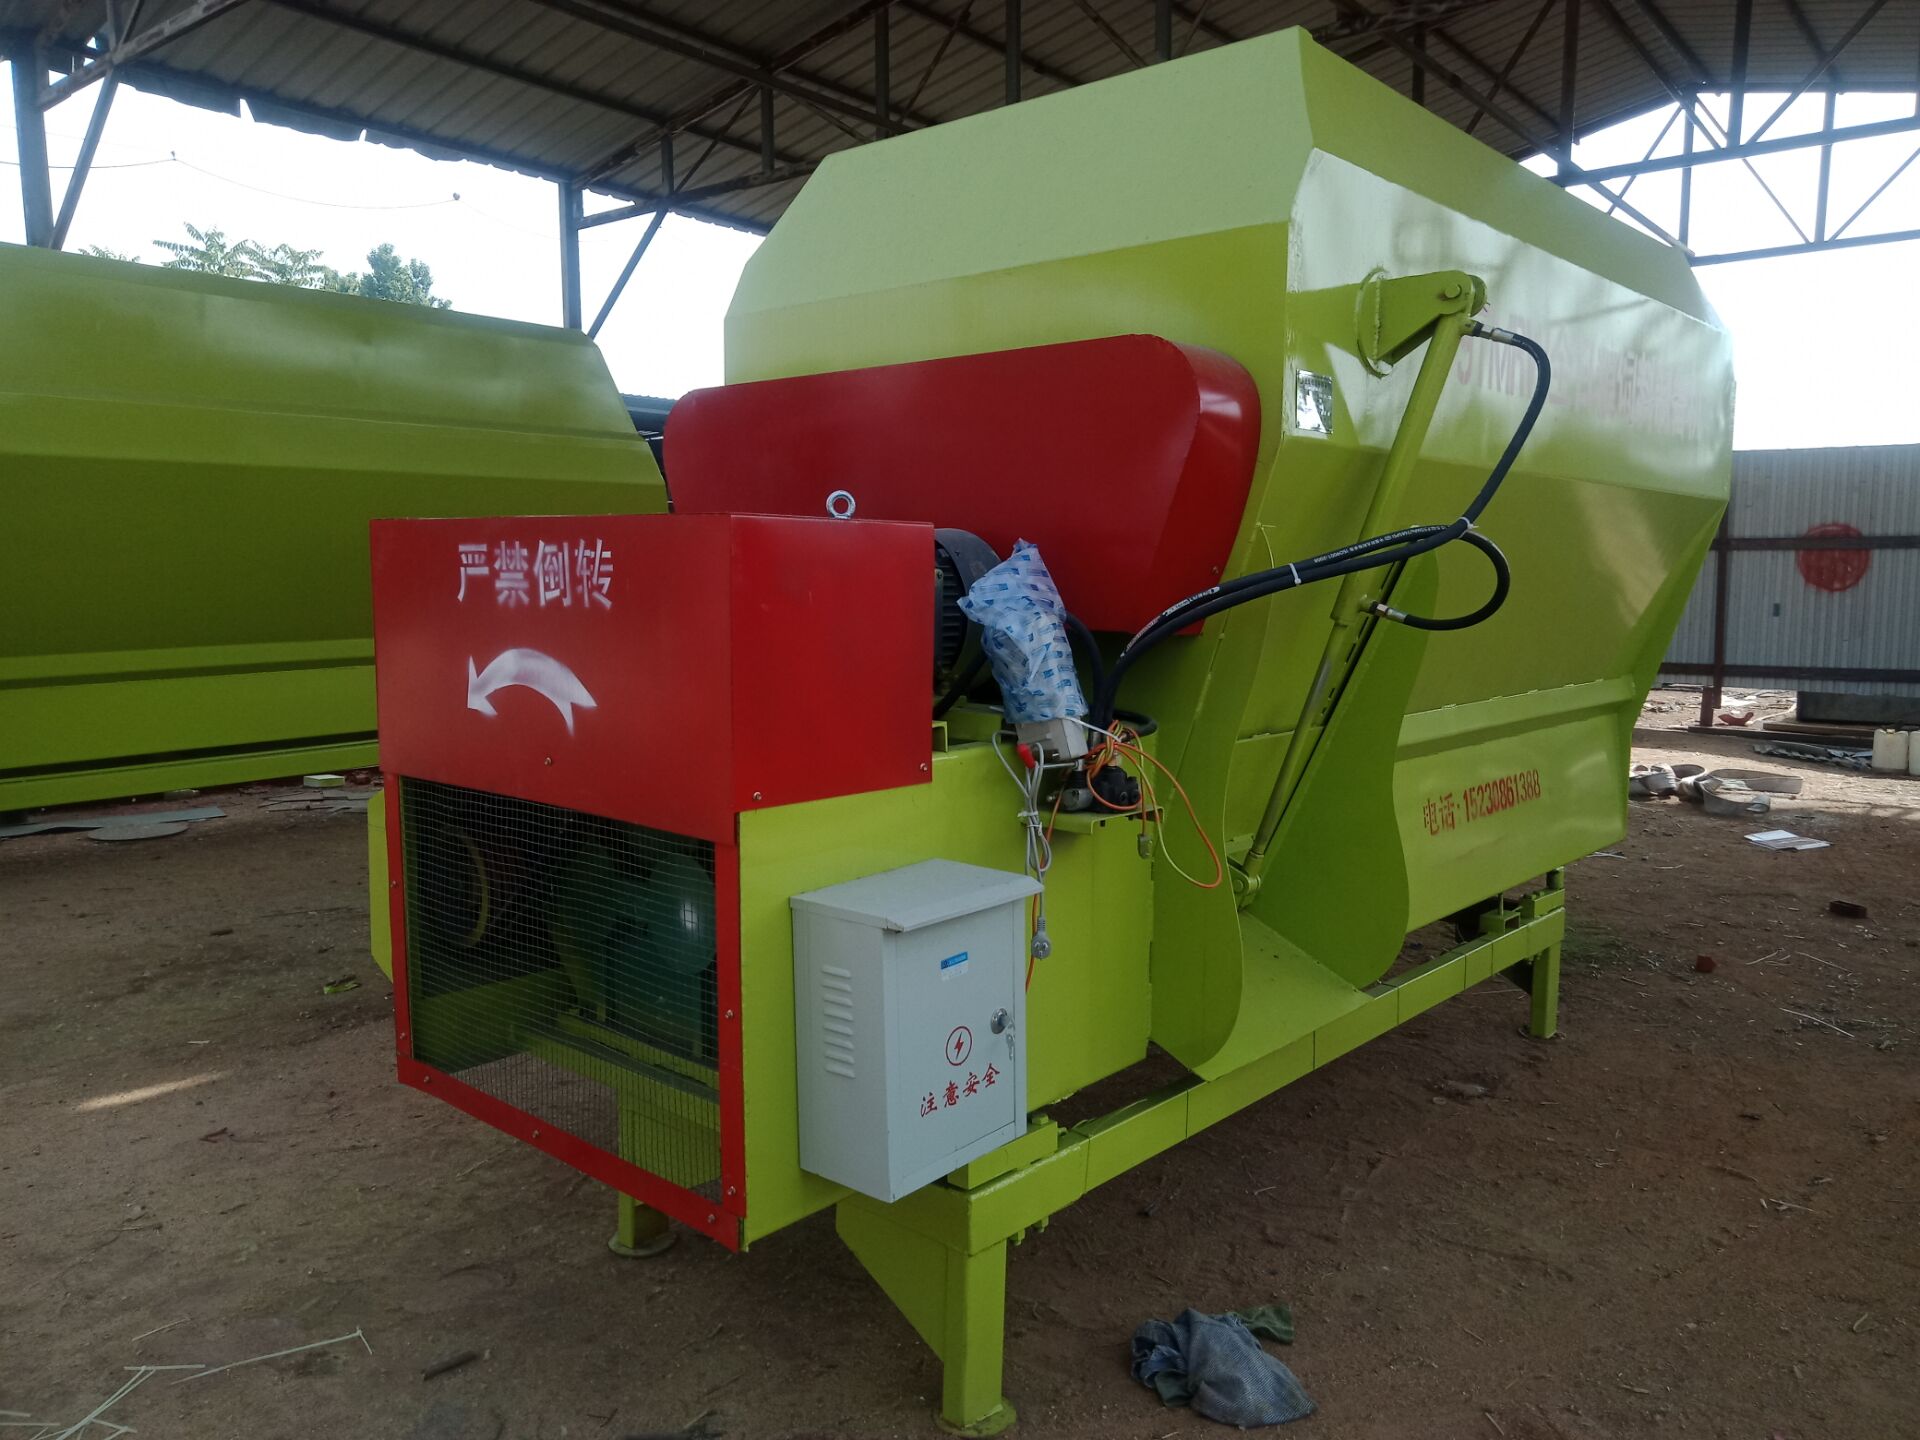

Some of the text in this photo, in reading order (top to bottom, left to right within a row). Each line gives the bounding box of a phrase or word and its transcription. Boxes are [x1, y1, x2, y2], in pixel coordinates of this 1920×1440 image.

[457, 538, 614, 609] 严禁倒转
[920, 1063, 1000, 1117] 注意安全
